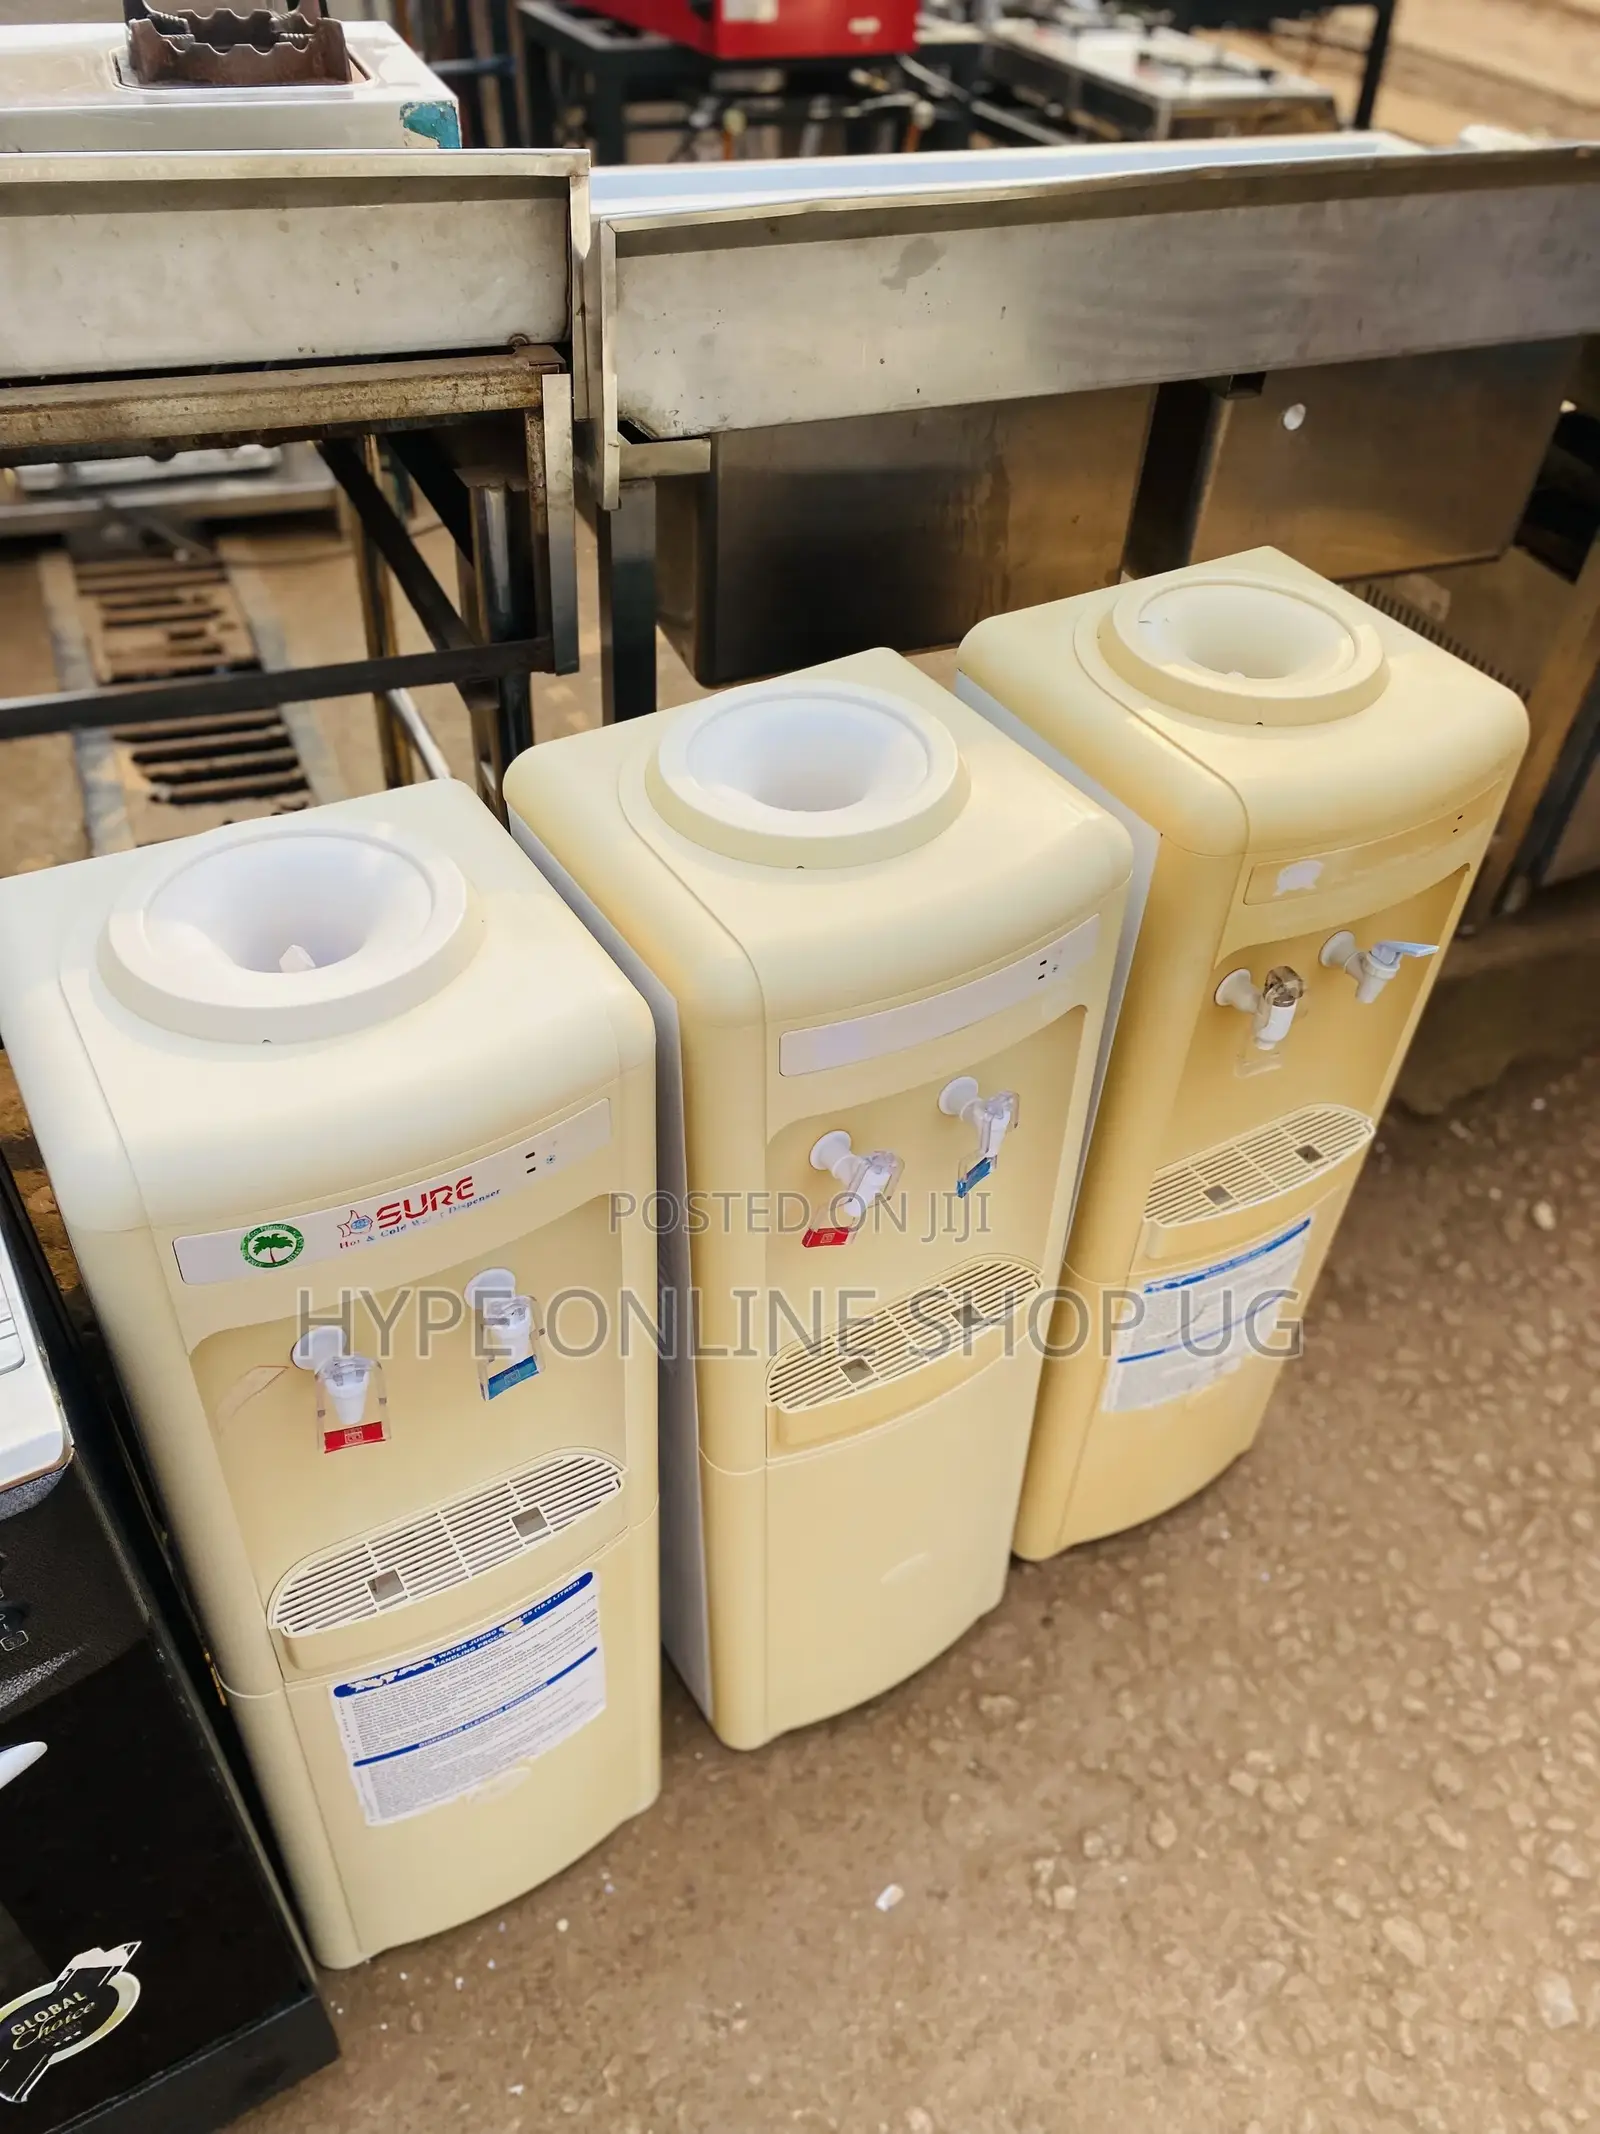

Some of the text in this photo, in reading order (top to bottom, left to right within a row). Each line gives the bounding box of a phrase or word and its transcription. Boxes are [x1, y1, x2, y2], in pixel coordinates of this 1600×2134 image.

[376, 1175, 475, 1229] SURE
[433, 1646, 477, 1667] HANDLING
[438, 1644, 467, 1659] WATER
[469, 1629, 498, 1646] JUMBO
[10, 1991, 88, 2036] GLOBAL
[12, 2001, 96, 2051] Choice
